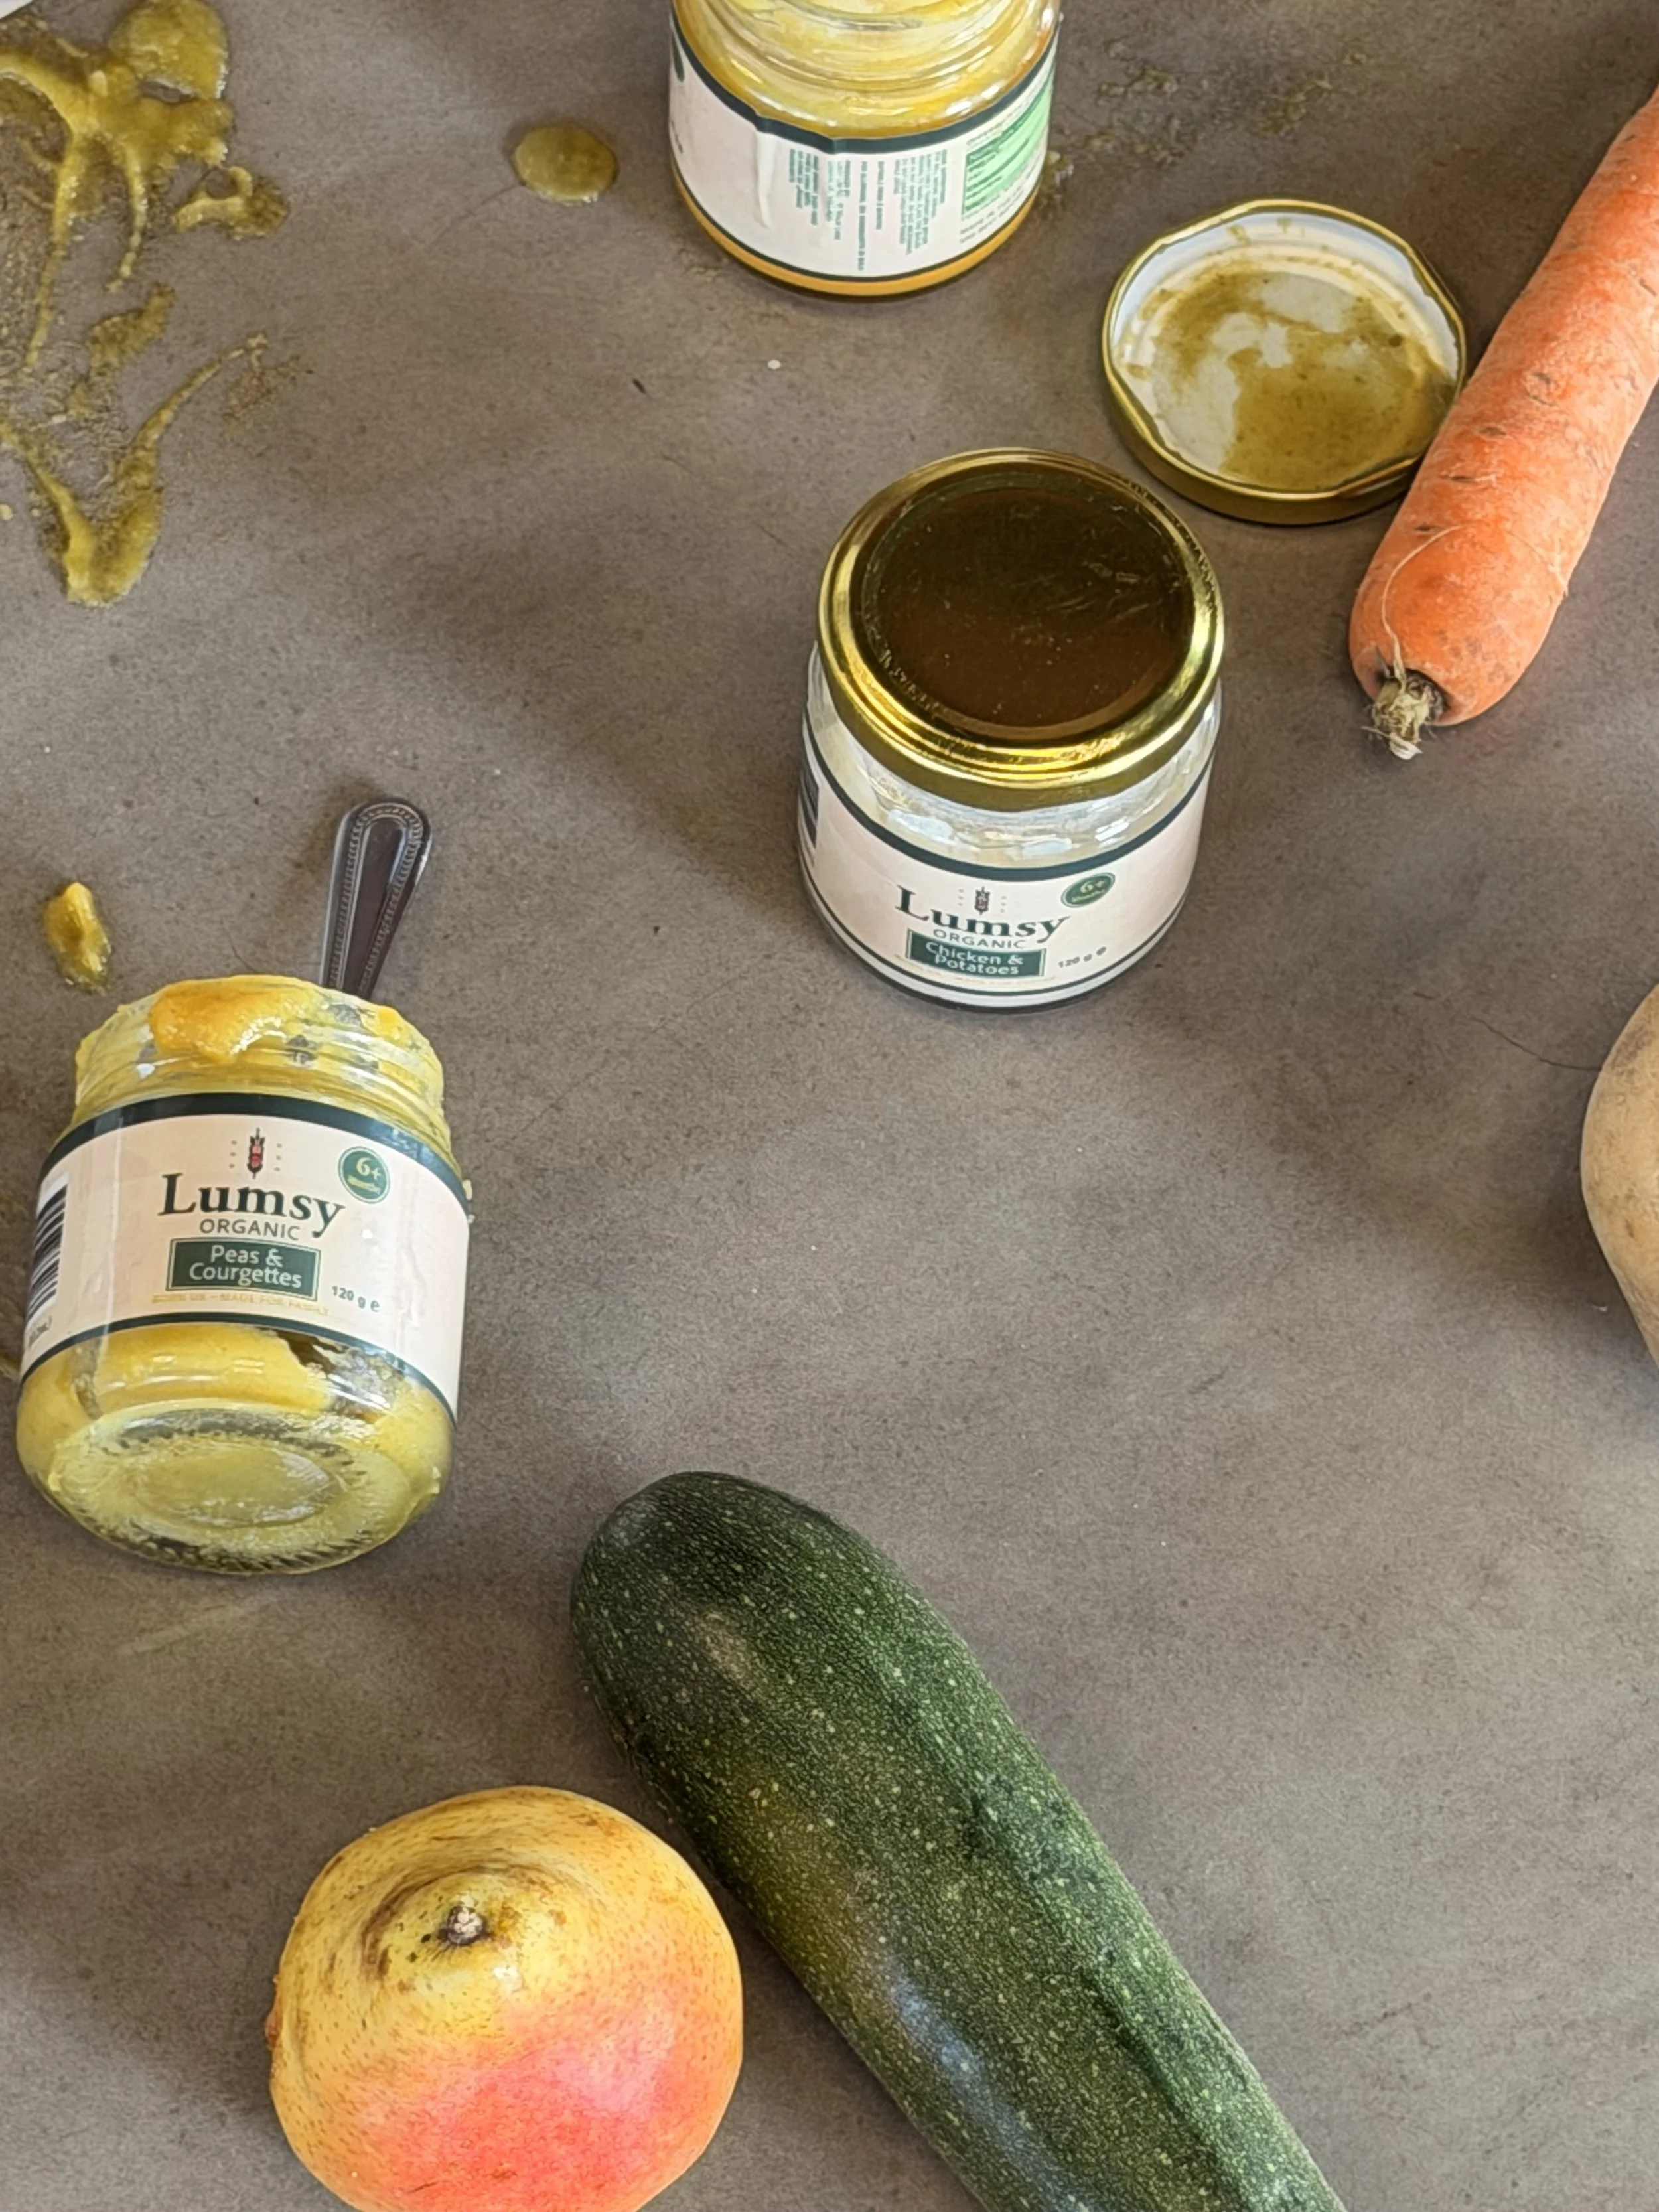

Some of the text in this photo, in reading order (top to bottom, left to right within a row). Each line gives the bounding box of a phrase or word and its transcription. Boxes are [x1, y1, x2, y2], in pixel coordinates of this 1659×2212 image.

[895, 885, 1070, 944] Lumsy
[933, 929, 1027, 949] ORGANIC
[926, 941, 1001, 965] Chicken
[1007, 954, 1024, 966] &
[934, 953, 1019, 975] Potatoes
[356, 1157, 382, 1181] 6+
[157, 1172, 346, 1239] Lumsy
[199, 1218, 301, 1241] ORGANIC
[210, 1244, 284, 1268] Peas &
[188, 1262, 303, 1289] Courgettes
[332, 1285, 354, 1301] 120
[370, 1300, 380, 1313] e
